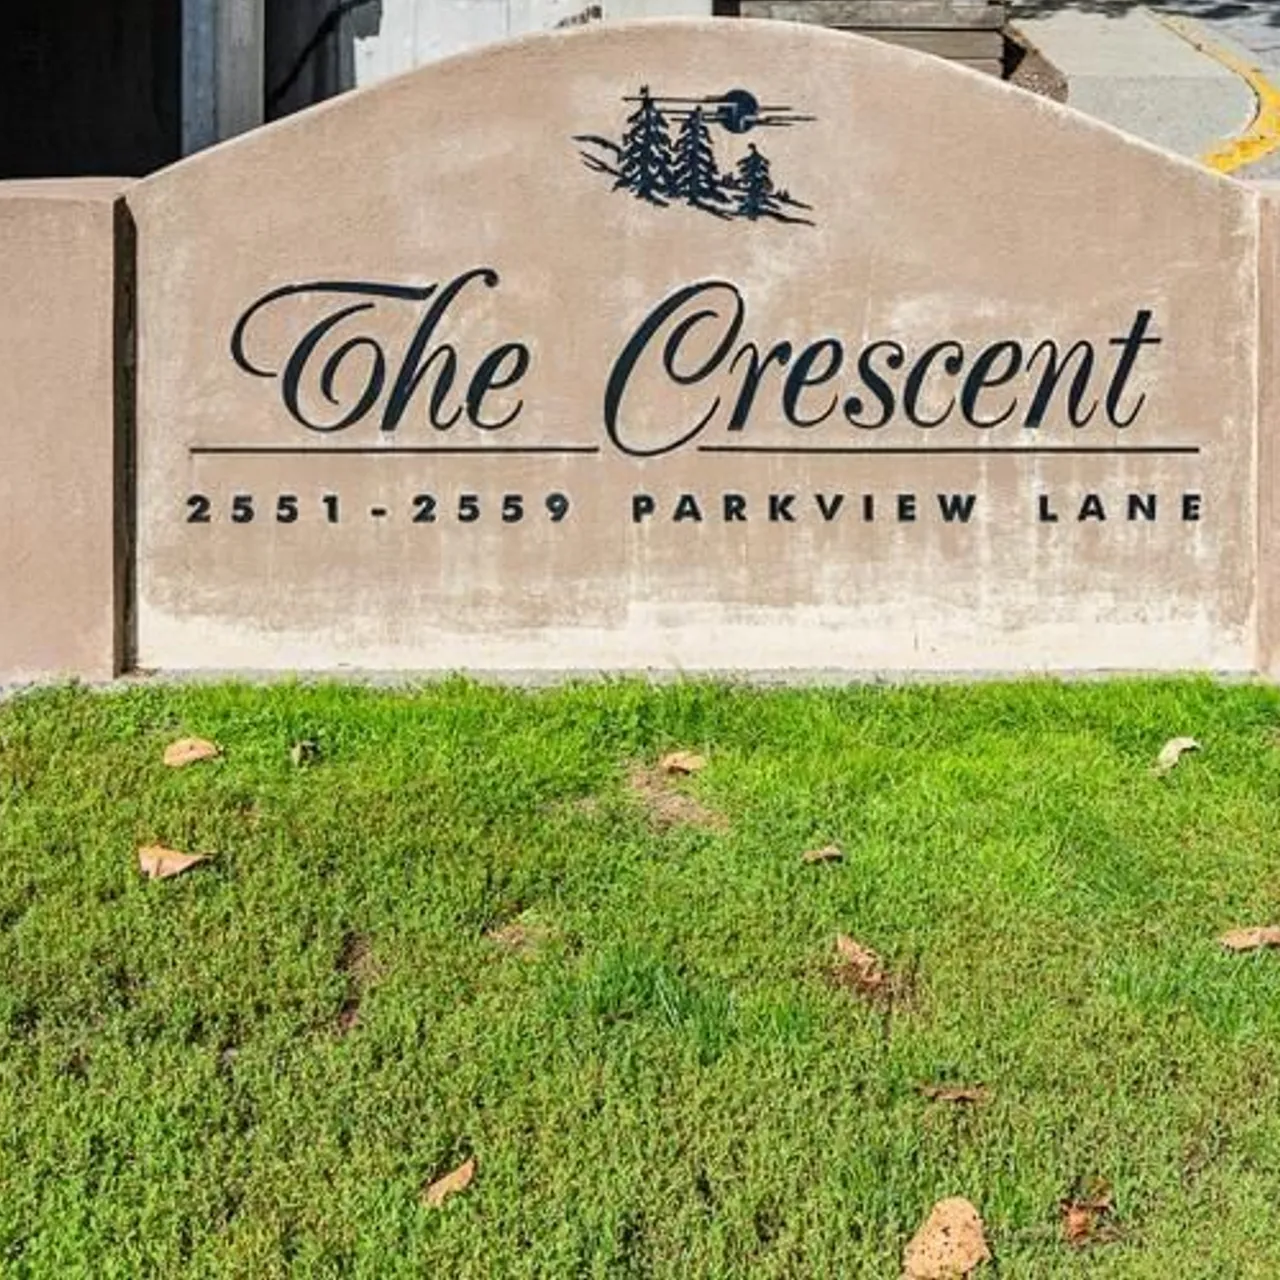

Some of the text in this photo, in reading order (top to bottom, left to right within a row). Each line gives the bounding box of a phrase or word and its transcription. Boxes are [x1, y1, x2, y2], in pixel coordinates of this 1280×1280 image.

[228, 267, 1164, 457] The Crescent
[185, 492, 1203, 524] 2551-2559 PARKVIEW LANE
